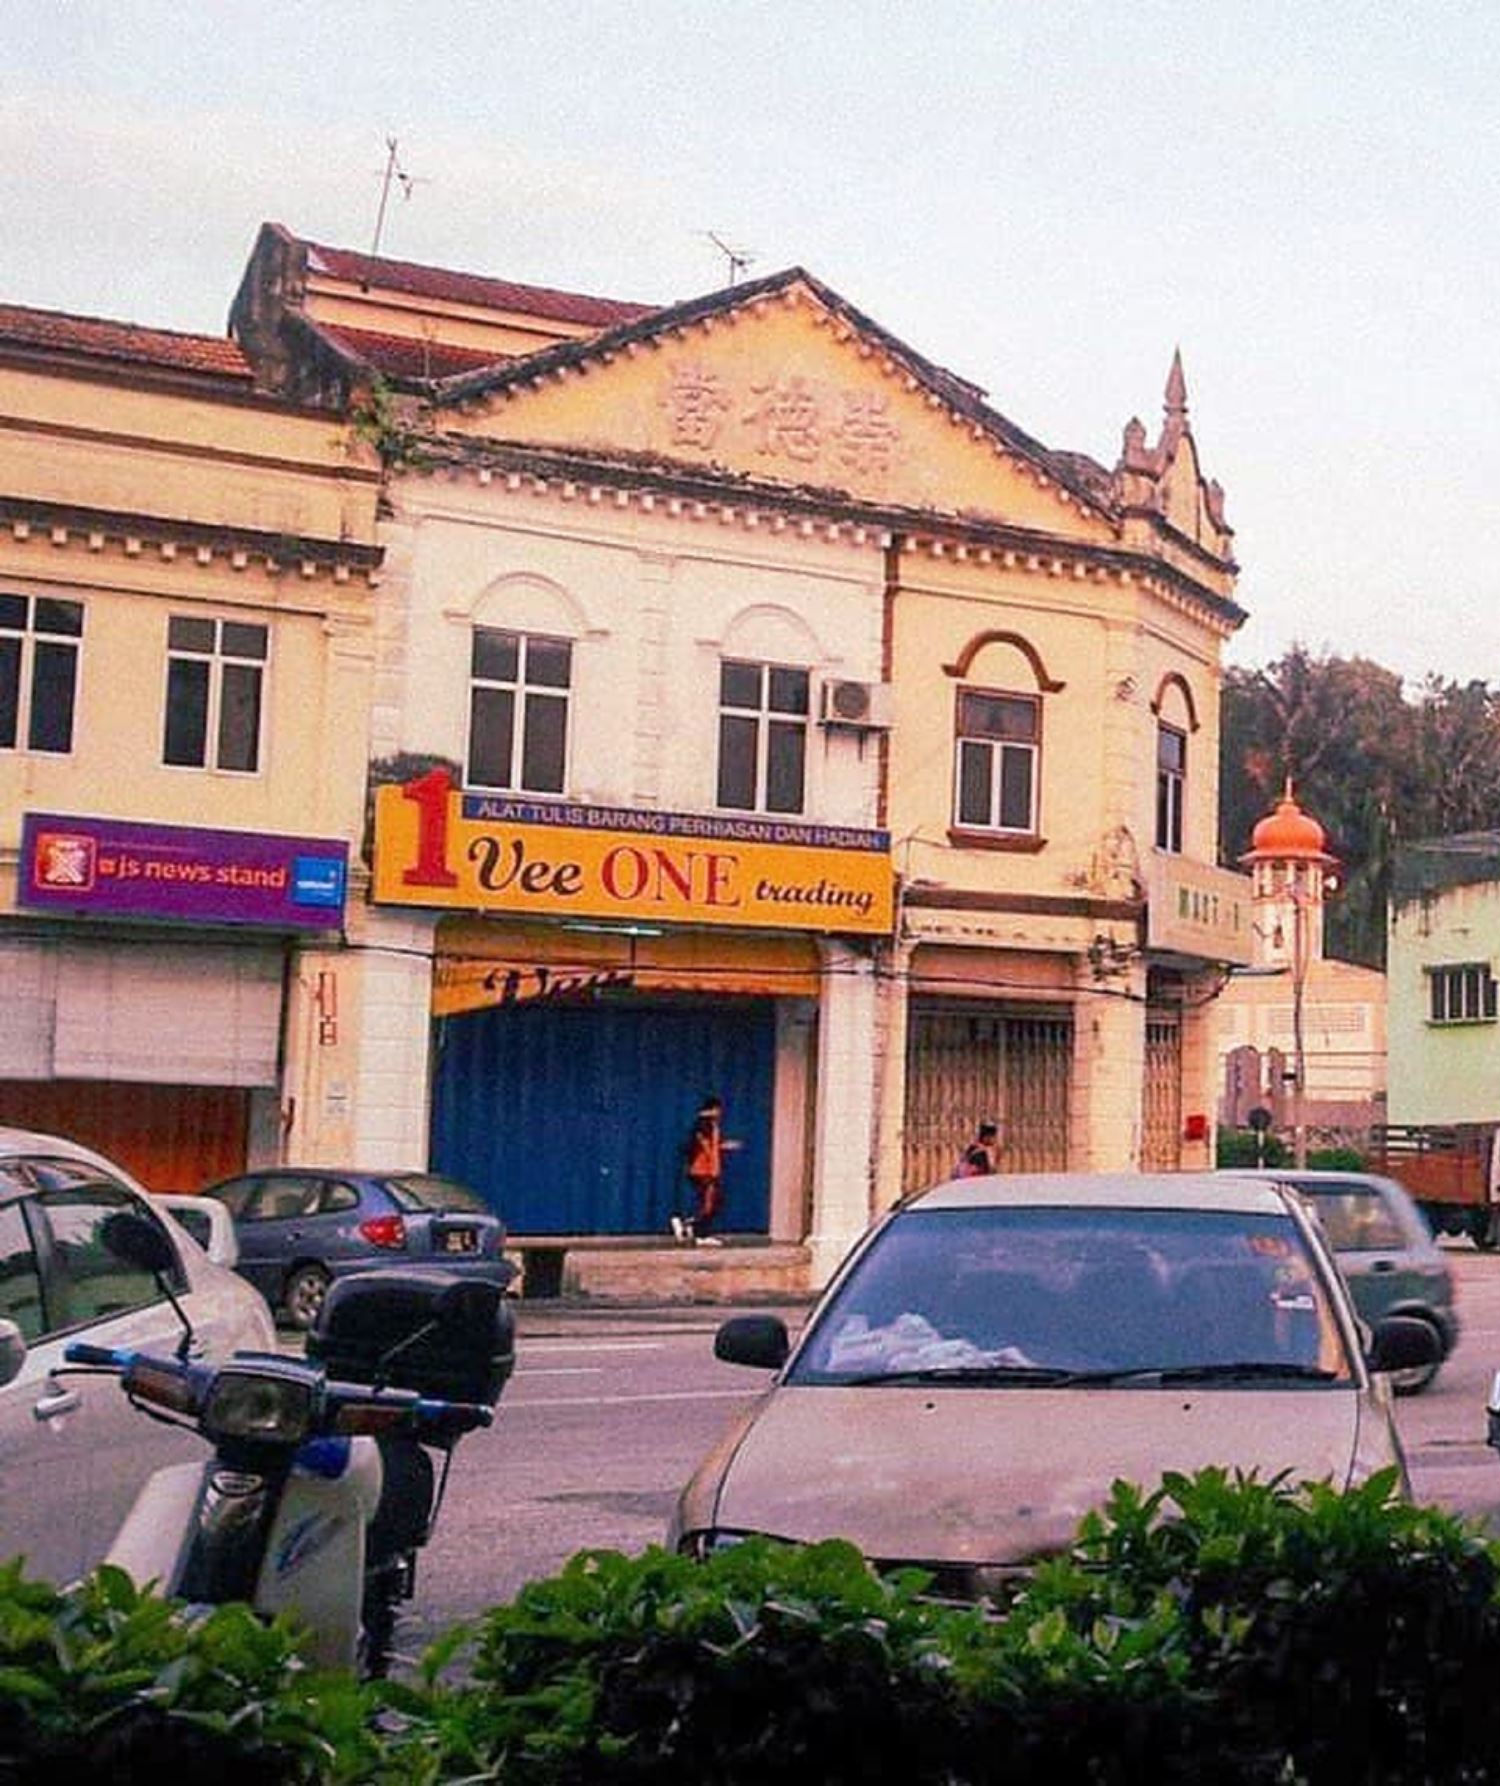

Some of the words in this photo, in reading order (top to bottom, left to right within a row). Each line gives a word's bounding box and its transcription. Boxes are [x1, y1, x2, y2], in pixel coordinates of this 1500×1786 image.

[402, 766, 459, 888] 1
[477, 800, 526, 818] ALAT
[532, 804, 584, 824] TULIS
[588, 809, 666, 833] BARANG
[669, 815, 771, 841] PERHIASAN
[775, 825, 811, 844] DAN
[815, 829, 880, 848] HADIAH
[117, 855, 140, 881] js
[145, 859, 211, 883] news
[216, 863, 287, 888] stand
[467, 836, 584, 896] Vee
[602, 846, 742, 908] ONE
[756, 879, 874, 916] trading
